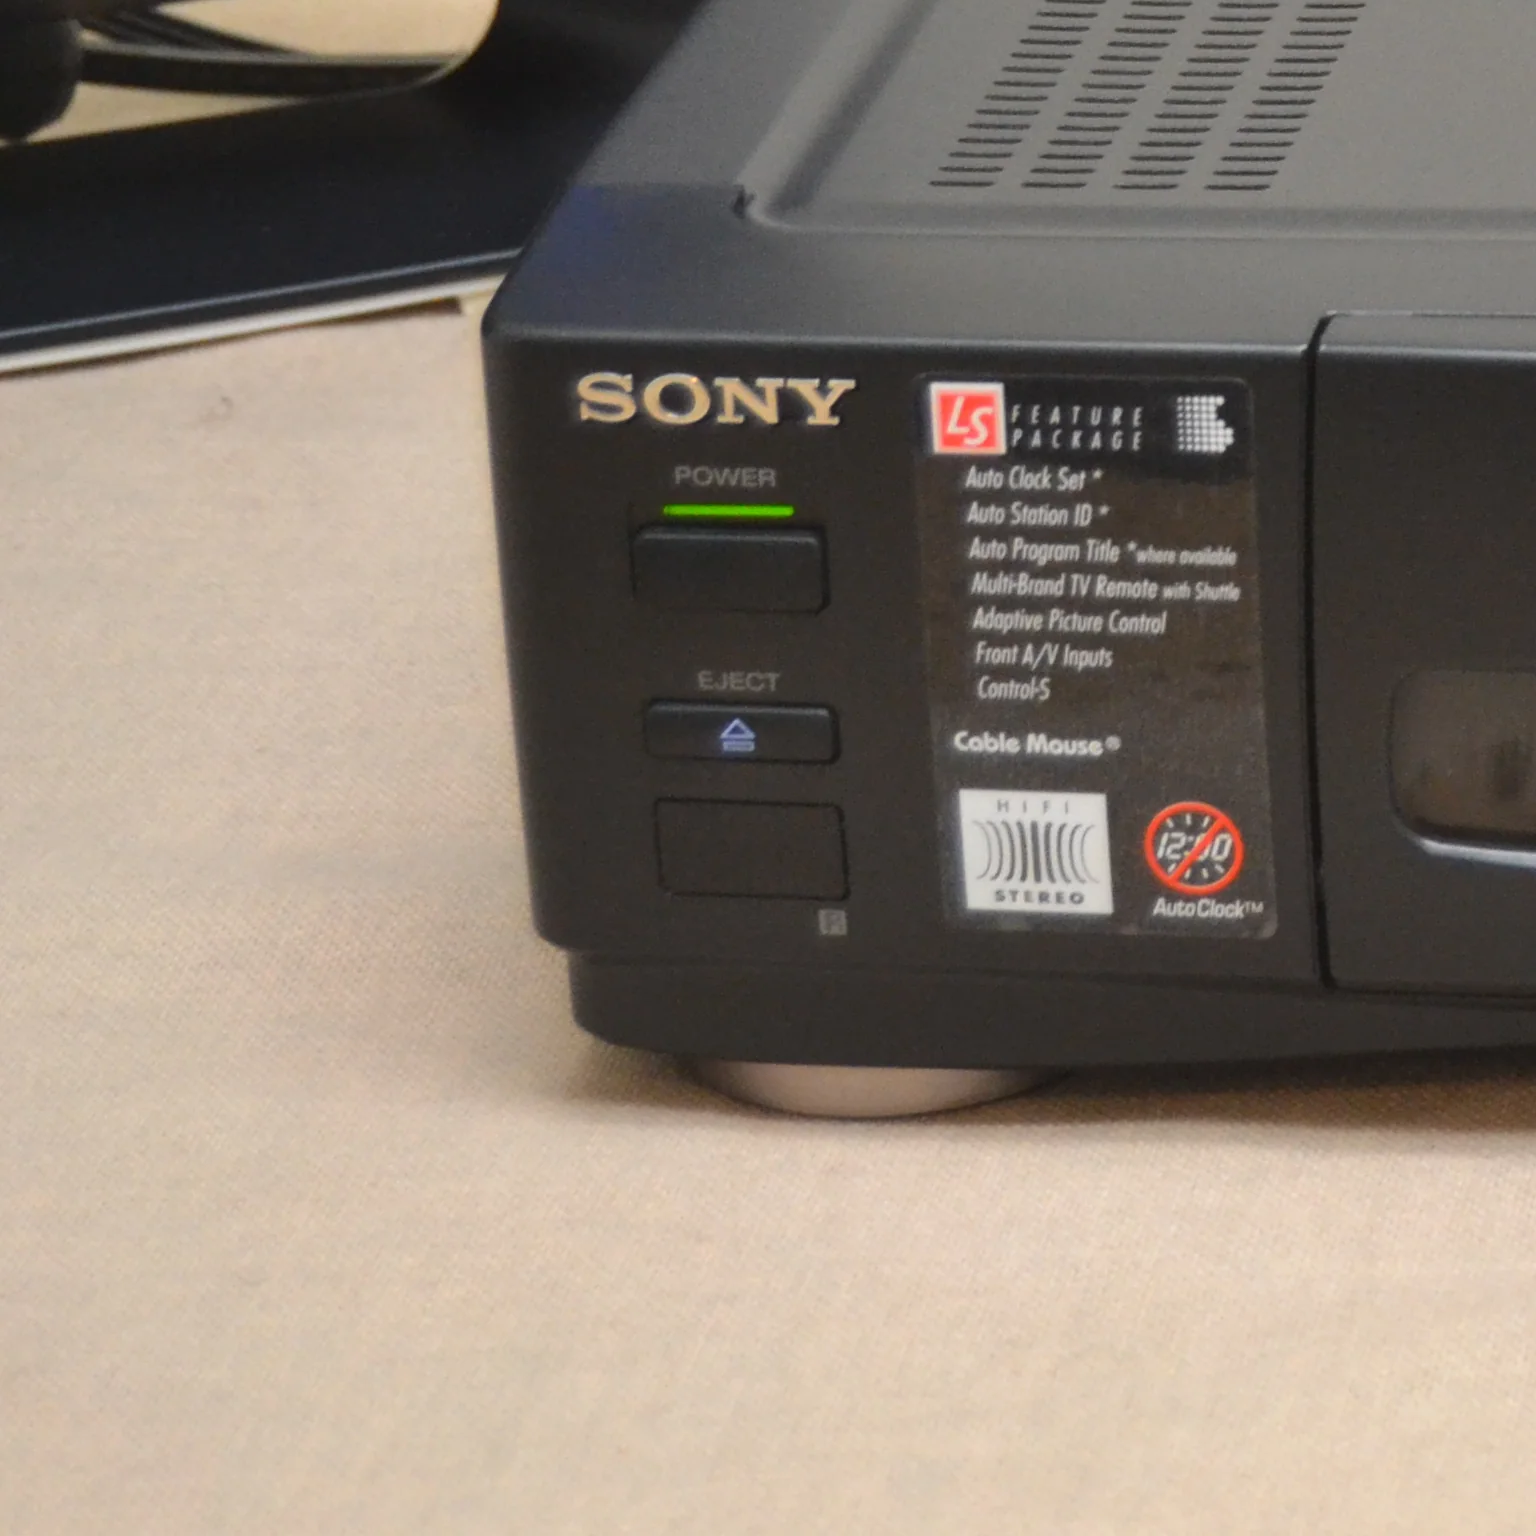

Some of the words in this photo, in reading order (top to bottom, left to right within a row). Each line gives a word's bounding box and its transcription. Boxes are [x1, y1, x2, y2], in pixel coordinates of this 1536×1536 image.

[577, 372, 857, 425] SONY
[1010, 404, 1143, 428] FEATURE
[1010, 429, 1143, 452] PACKAGE
[674, 465, 776, 488] POWER
[966, 466, 1004, 490] Auto
[1008, 467, 1052, 490] Clock
[1058, 467, 1086, 491] Set
[966, 502, 1005, 525] Auto
[1010, 502, 1068, 527] Station
[1075, 503, 1092, 526] ID
[969, 536, 1007, 560] Auto
[1012, 537, 1080, 566] Program
[1086, 539, 1121, 564] Title
[1180, 546, 1238, 566] available
[970, 571, 1064, 596] Multi-Brand
[1071, 574, 1091, 596] TV
[1096, 575, 1158, 599] Remote
[1163, 582, 1191, 600] with
[1195, 582, 1241, 602] Shuttle
[973, 606, 1043, 634] Adaptive
[1049, 608, 1103, 632] Picture
[1109, 610, 1167, 635] Control
[975, 640, 1018, 665] Front
[1022, 642, 1059, 671] A/V
[1064, 644, 1113, 672] Inputs
[697, 670, 781, 693] EJECT
[977, 675, 1051, 701] Control-S
[954, 730, 1020, 754] Cable
[995, 889, 1086, 905] STEREO
